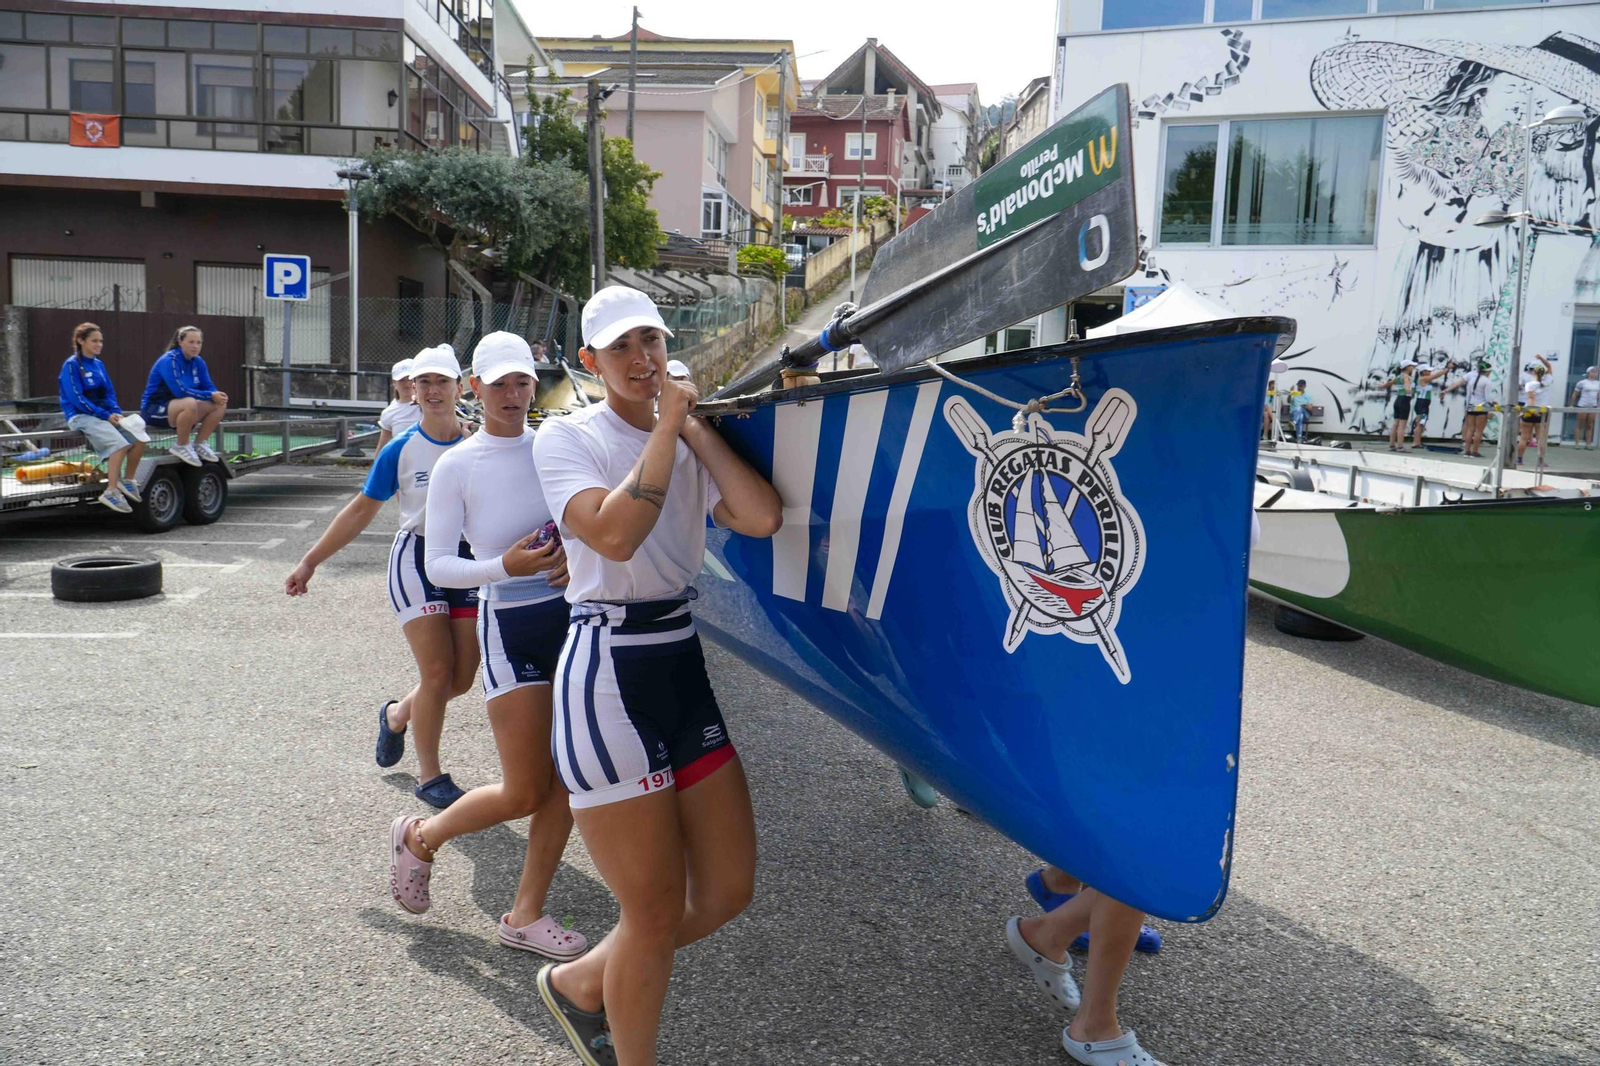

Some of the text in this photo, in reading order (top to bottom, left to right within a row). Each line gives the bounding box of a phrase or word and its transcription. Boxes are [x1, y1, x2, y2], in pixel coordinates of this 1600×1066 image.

[1019, 143, 1059, 179] Perillo
[976, 148, 1084, 236] McDonald's
[273, 262, 302, 294] P
[988, 449, 1119, 582] CLUB REGATAS PERILLO
[420, 604, 448, 614] 1970
